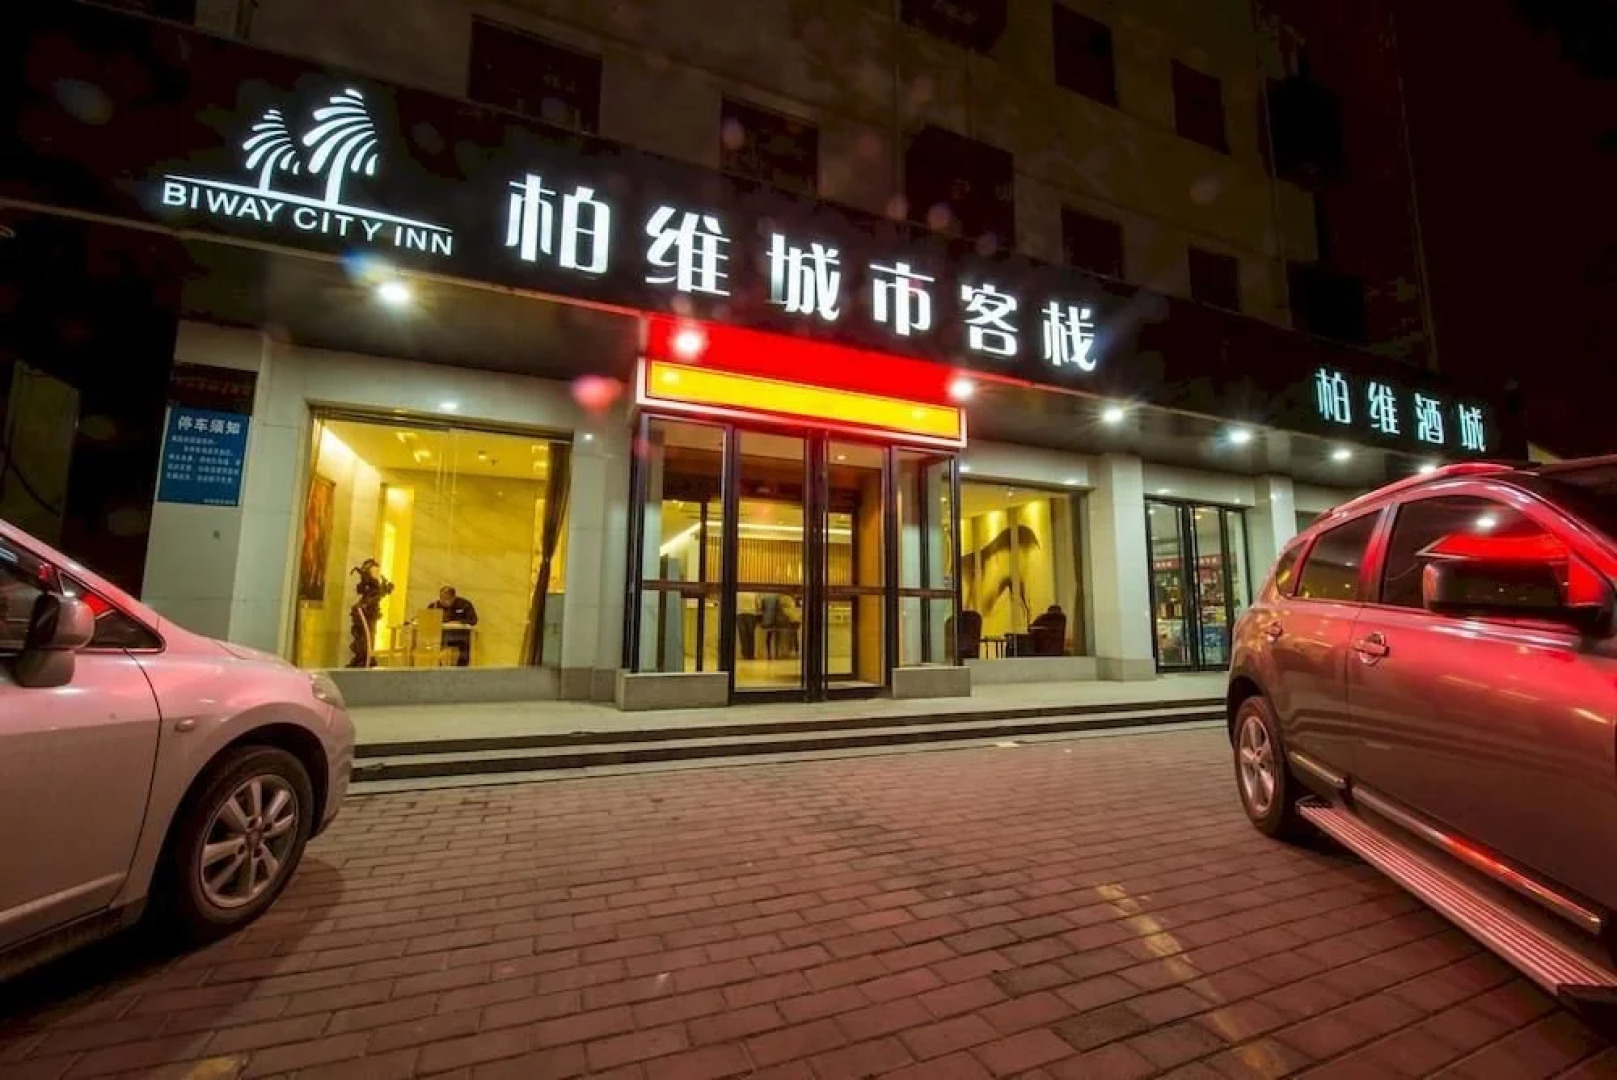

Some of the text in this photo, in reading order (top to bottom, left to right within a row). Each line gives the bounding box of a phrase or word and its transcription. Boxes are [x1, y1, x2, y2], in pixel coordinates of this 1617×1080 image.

[293, 207, 382, 242] CITY
[394, 225, 452, 256] INN
[504, 172, 1097, 372] 柏维城市客栈
[178, 414, 241, 435] 停车须知
[1314, 367, 1486, 452] 柏维酒城
